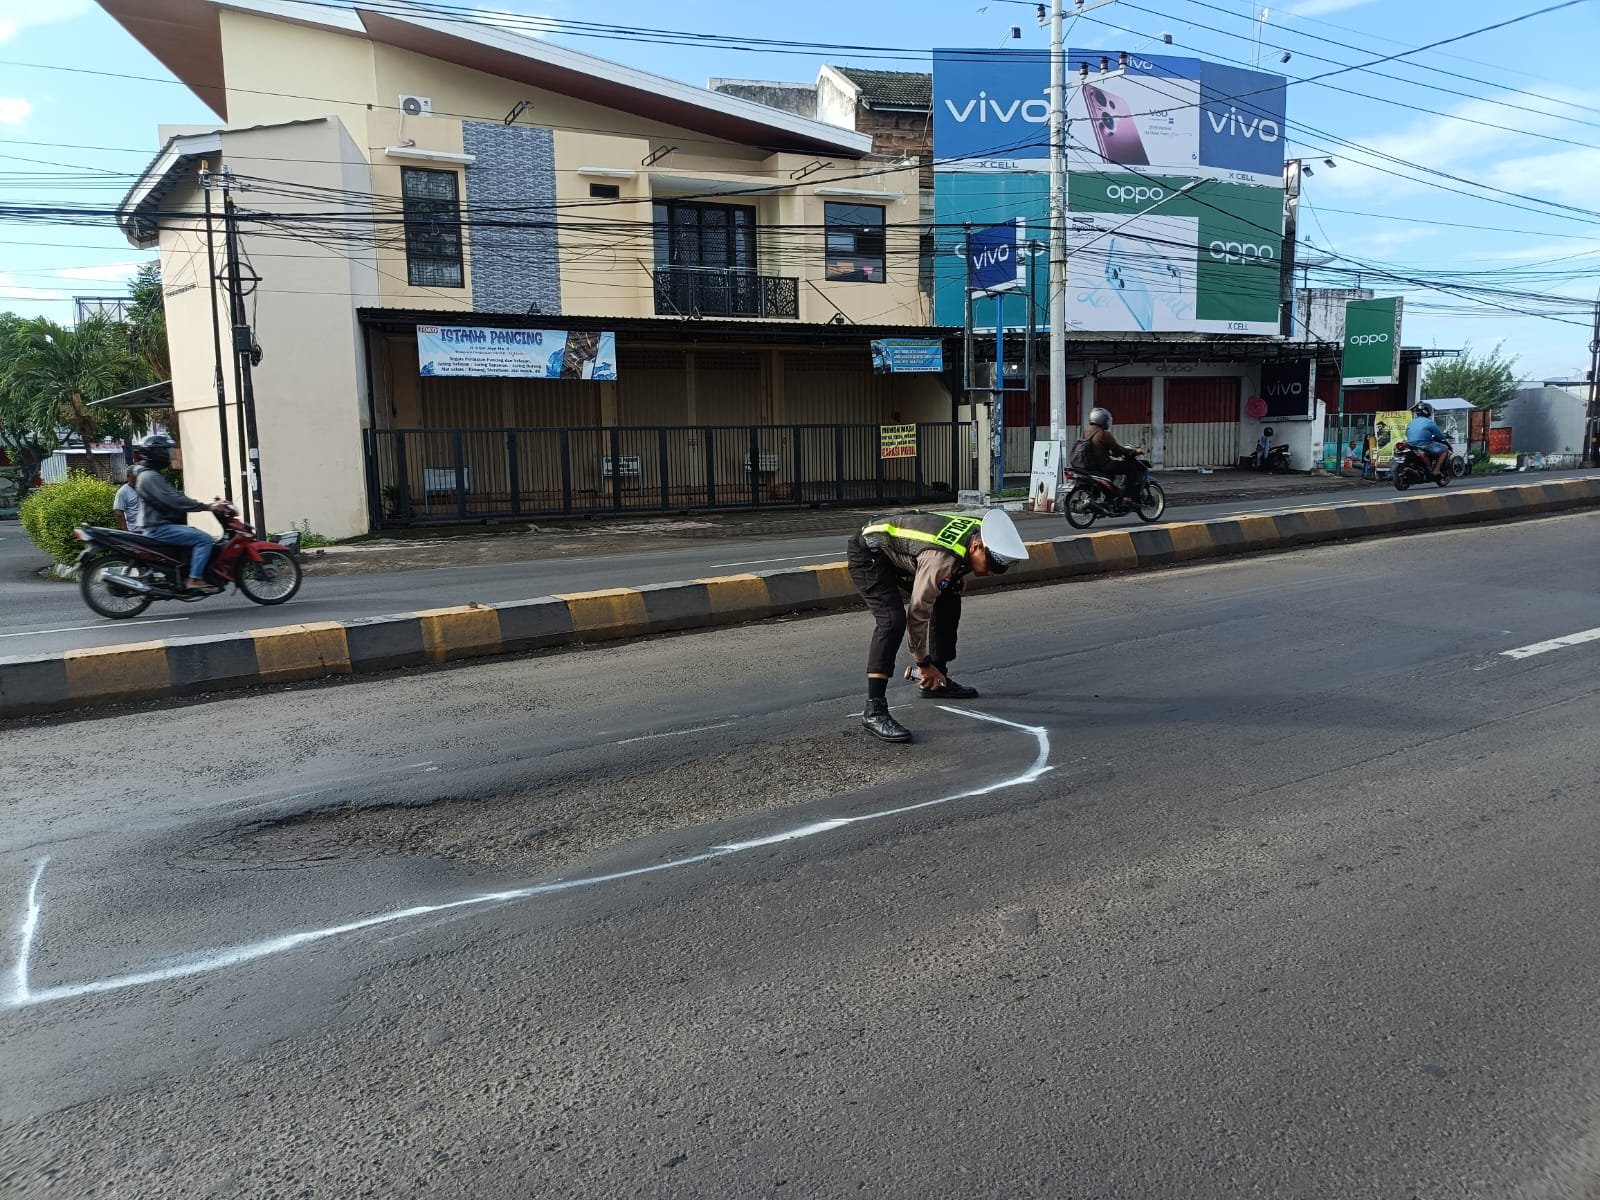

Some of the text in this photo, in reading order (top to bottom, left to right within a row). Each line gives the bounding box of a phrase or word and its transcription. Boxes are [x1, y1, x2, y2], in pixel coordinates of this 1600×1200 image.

[945, 91, 1051, 123] vivo
[1207, 106, 1279, 142] vivo
[990, 161, 1019, 169] CELL
[1235, 173, 1256, 182] CELL
[1107, 185, 1164, 203] oppo
[973, 244, 1010, 270] vivo
[1208, 240, 1274, 265] oppo
[1228, 322, 1249, 331] X CELL
[440, 328, 544, 346] ISTANA PANCING
[1350, 333, 1389, 346] oppo
[1156, 363, 1193, 374] oppo
[1266, 380, 1302, 397] vivo
[937, 518, 973, 546] POLISI
